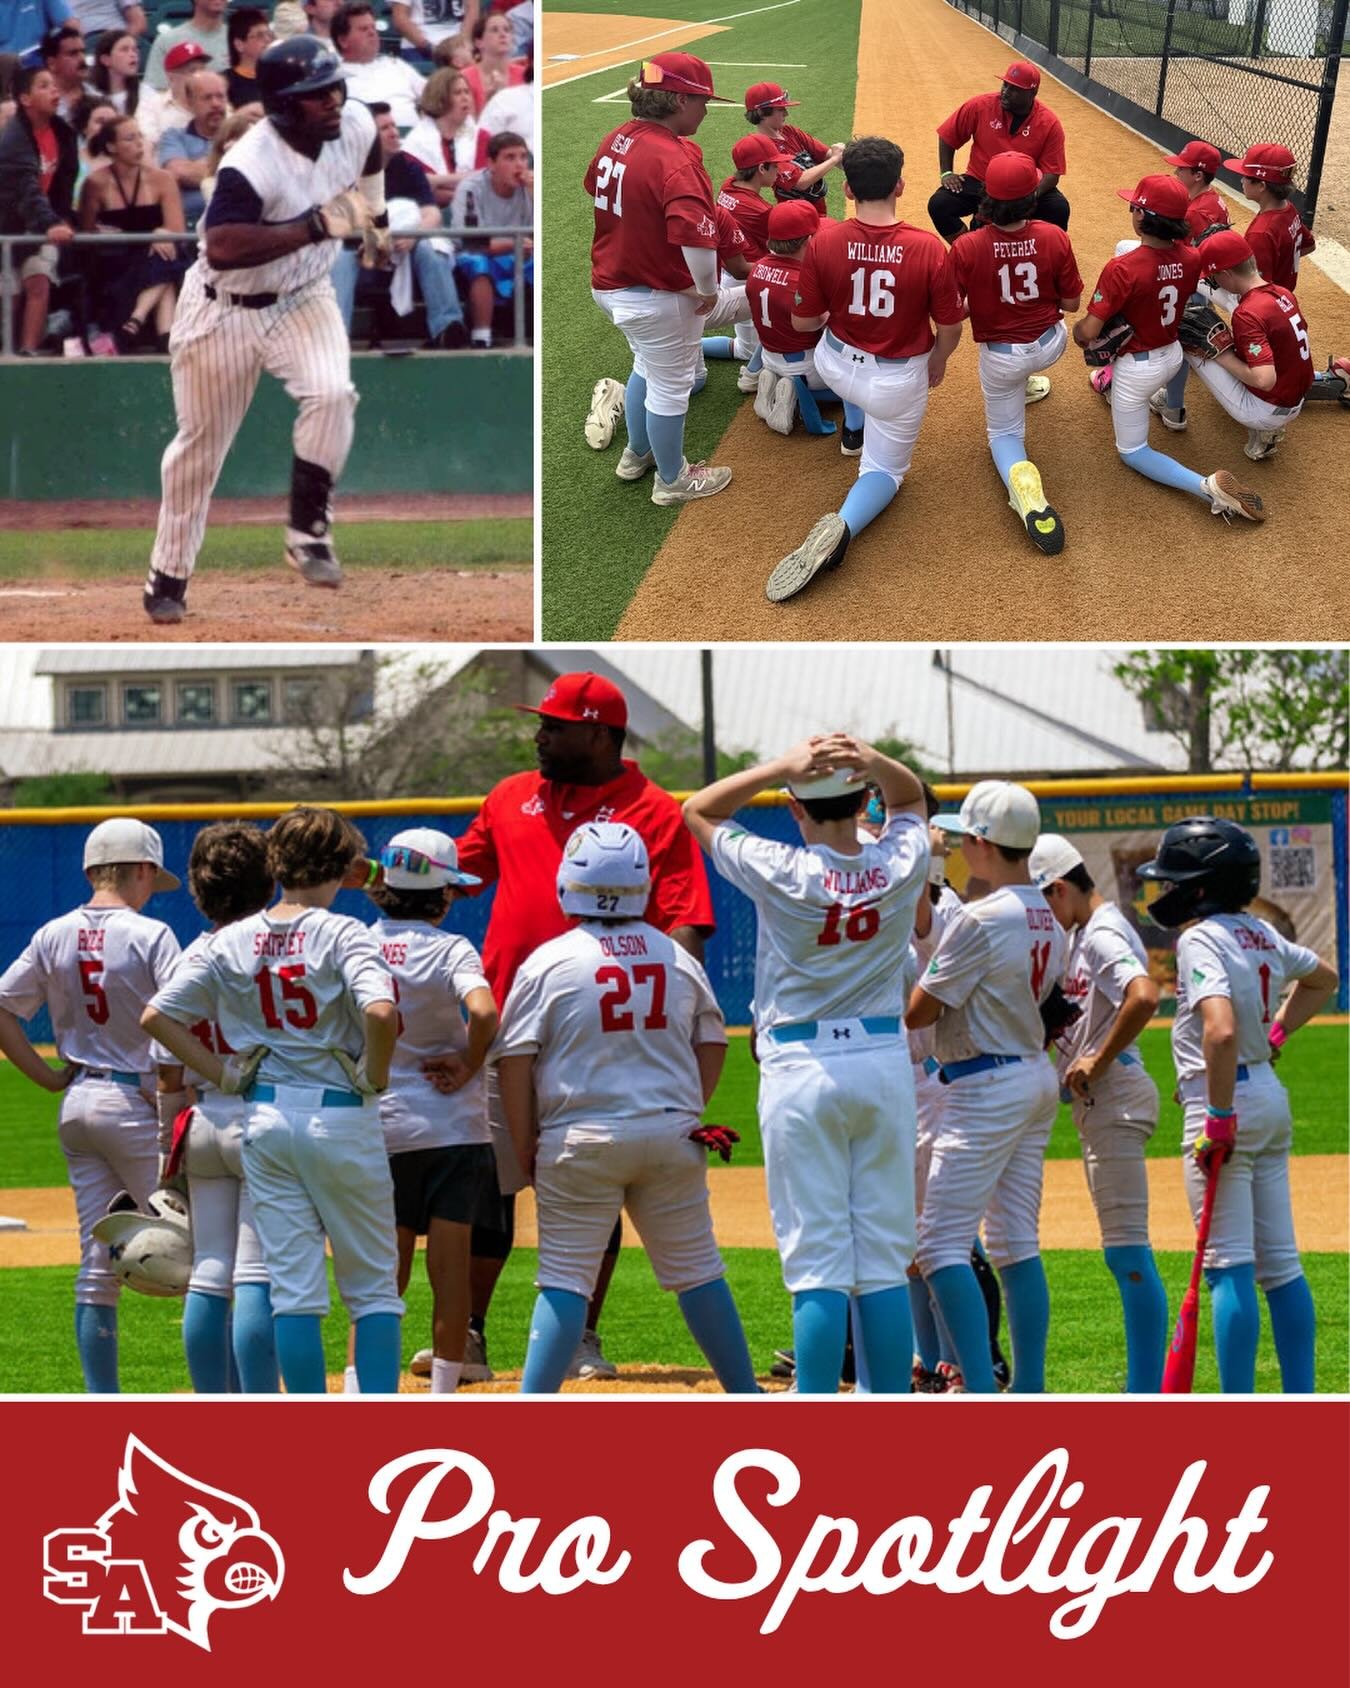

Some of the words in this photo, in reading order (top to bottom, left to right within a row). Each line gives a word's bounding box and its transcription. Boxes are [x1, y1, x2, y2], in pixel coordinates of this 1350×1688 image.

[595, 156, 626, 217] 27
[847, 242, 903, 264] WILLIAMS
[993, 238, 1037, 258] PETEREK
[848, 267, 896, 318] 16
[998, 261, 1039, 304] 13
[1157, 263, 1183, 281] JONES
[759, 287, 772, 328] 1
[1158, 284, 1178, 327] 3
[1288, 313, 1309, 361] 5
[1055, 809, 1100, 827] YOUR
[1105, 807, 1156, 825] LOCAL
[1162, 804, 1208, 823] GAME
[1212, 803, 1246, 820] DAY
[1250, 801, 1300, 820] STOP!
[823, 867, 889, 894] WILLIAMS
[597, 894, 619, 912] 27
[817, 898, 882, 946] 16
[382, 943, 408, 965] NES
[599, 935, 648, 957] OLSON
[78, 960, 110, 1025] 5
[253, 963, 318, 1030] 15
[595, 963, 667, 1032] 27
